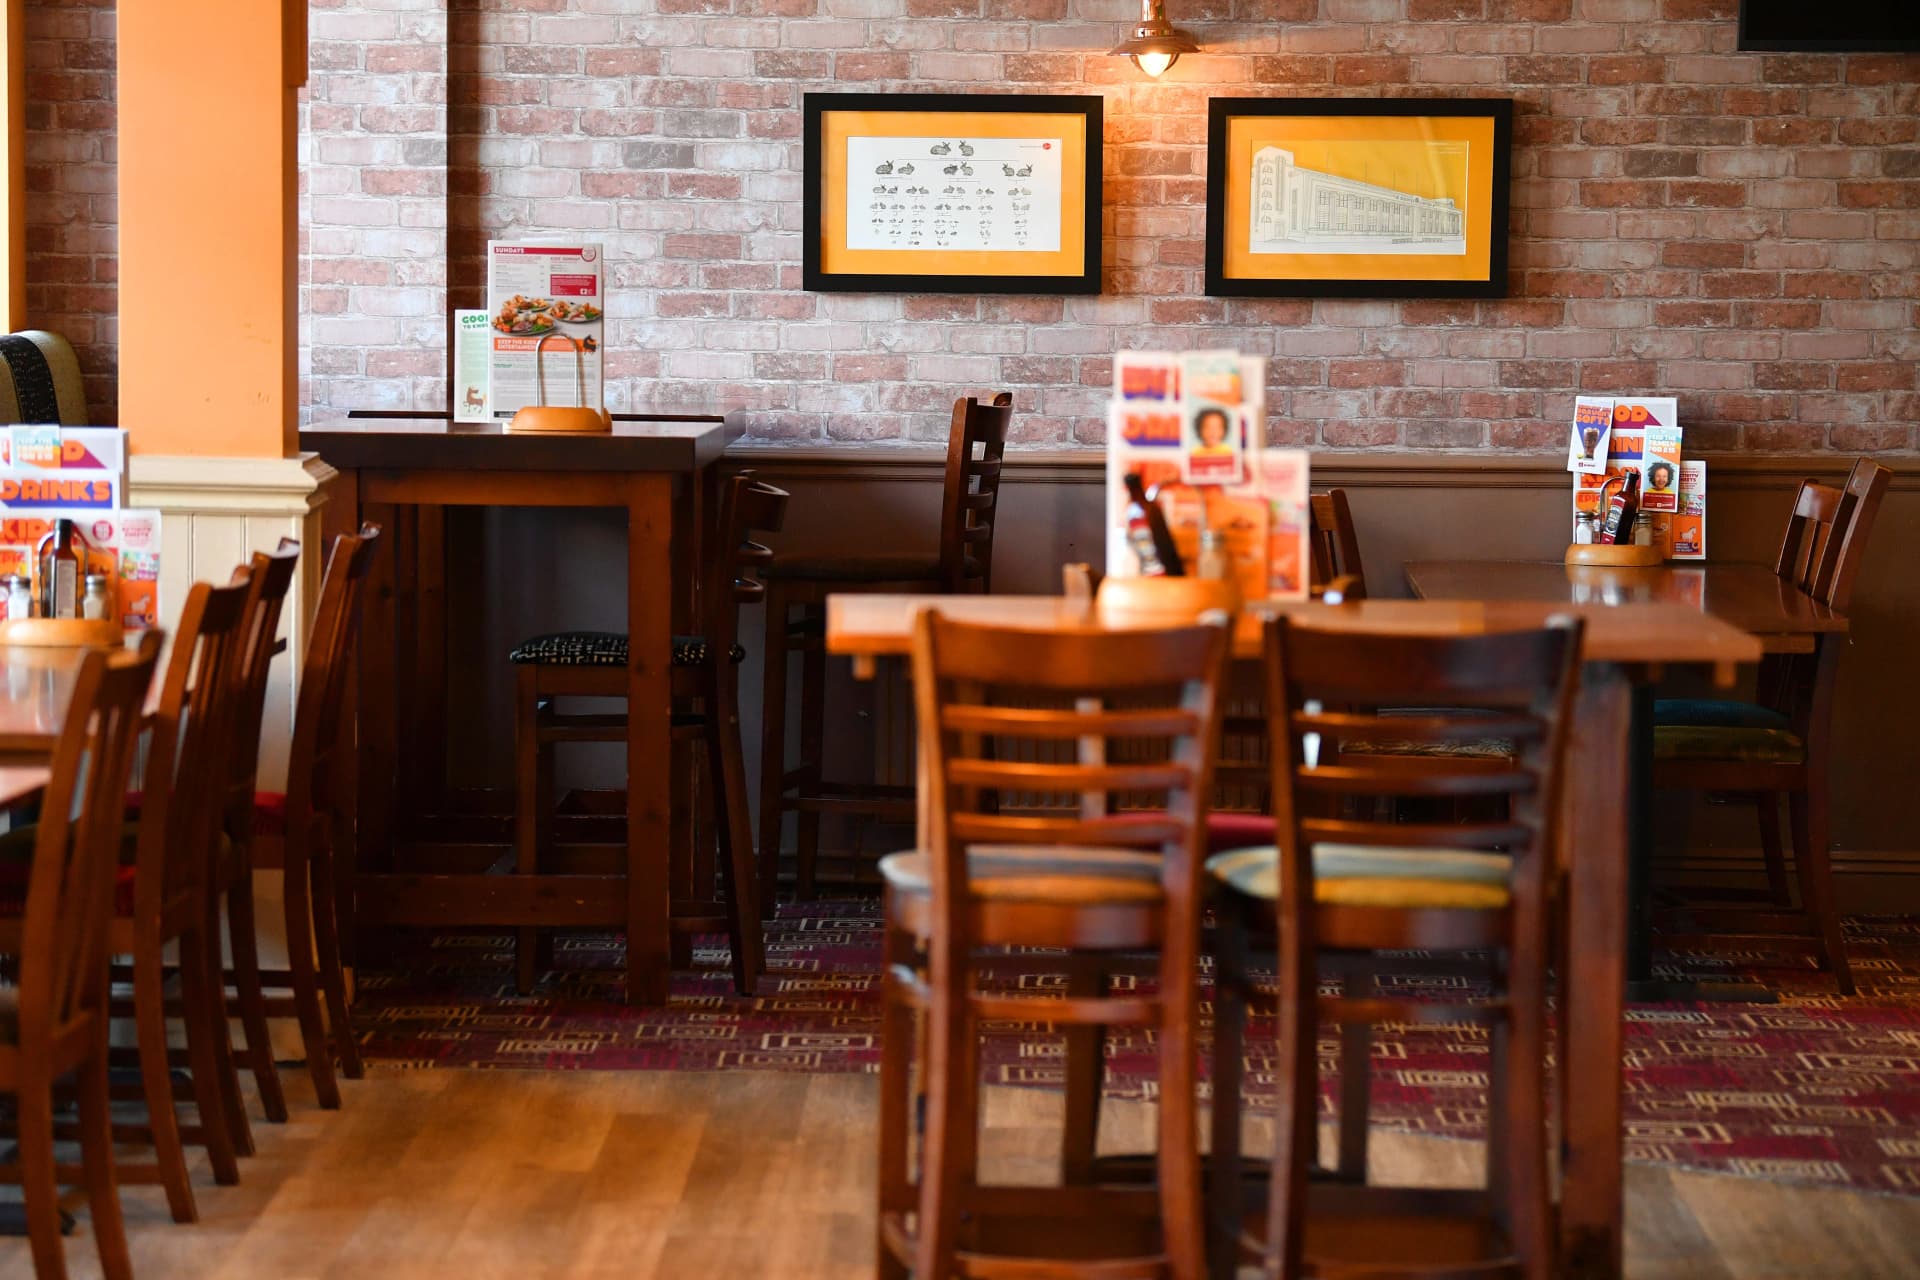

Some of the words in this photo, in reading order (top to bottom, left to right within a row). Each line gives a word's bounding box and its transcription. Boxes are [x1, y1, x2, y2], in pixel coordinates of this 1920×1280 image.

[1576, 414, 1610, 426] SOFTS
[1615, 405, 1648, 422] OD
[0, 480, 110, 501] DRINKS
[0, 518, 56, 540] KID
